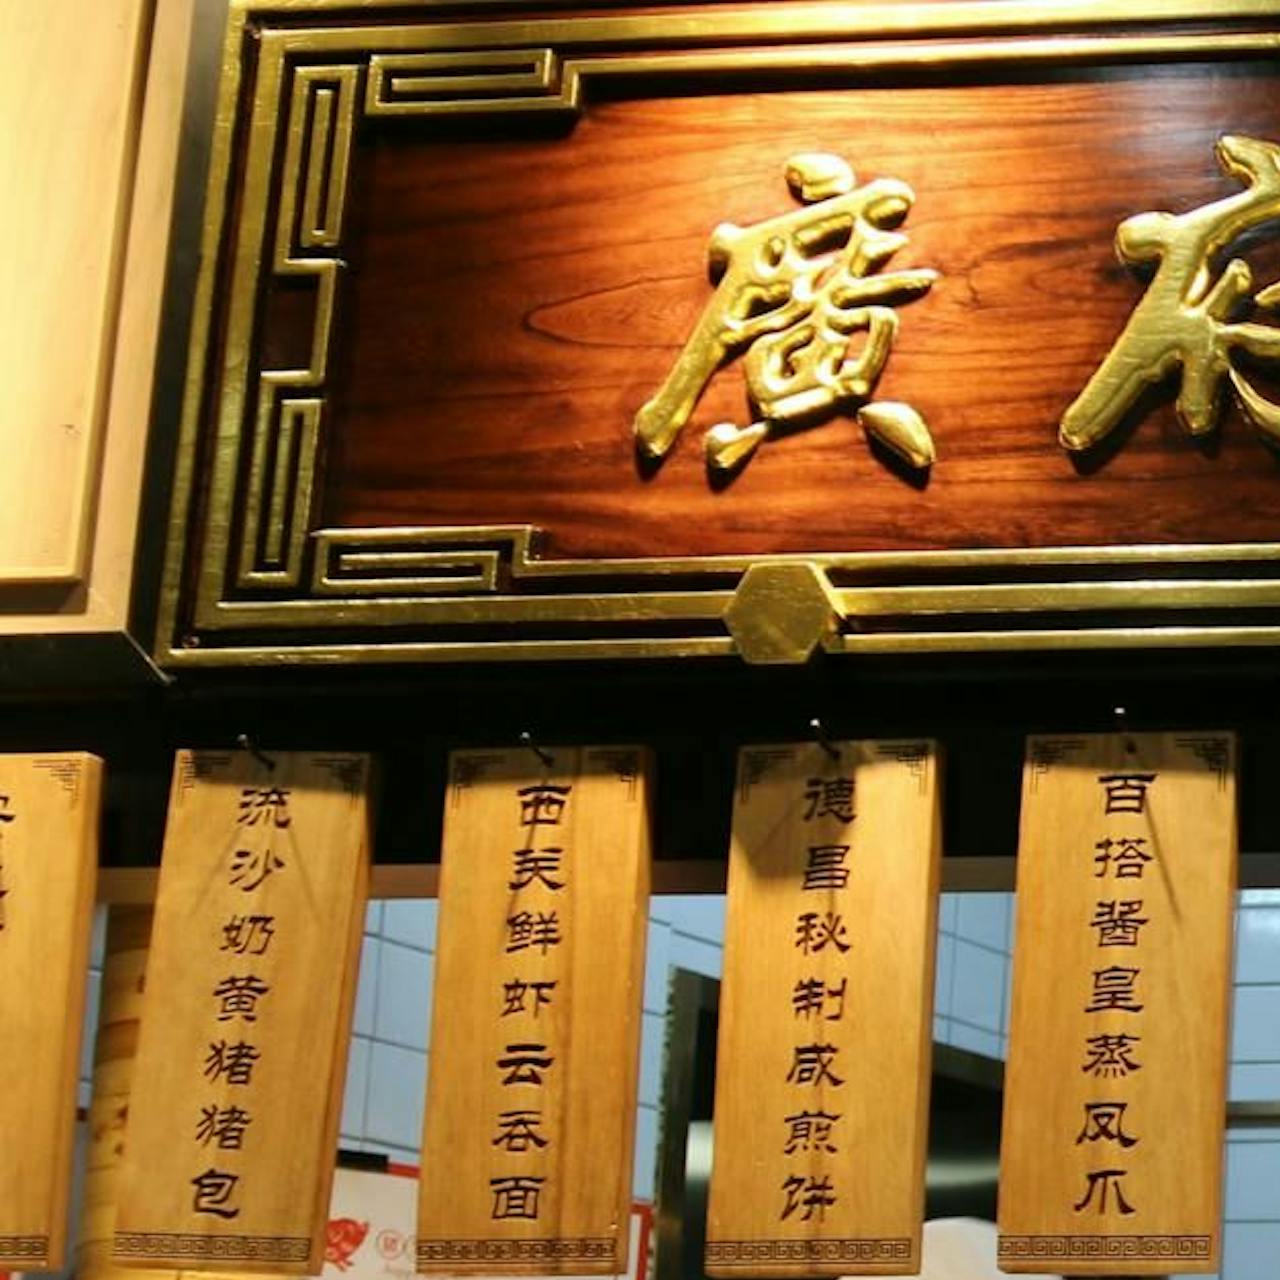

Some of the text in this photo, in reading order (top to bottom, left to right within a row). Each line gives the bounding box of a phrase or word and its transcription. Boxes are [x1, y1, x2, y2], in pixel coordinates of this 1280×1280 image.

[190, 787, 291, 1220] 流沙奶黄猪猪包
[489, 784, 571, 1221] 西关鲜虾云吞面
[780, 776, 859, 1224] 德昌秘制咸煎饼
[1074, 772, 1159, 1217] 百搭酱皇蒸凤爪
